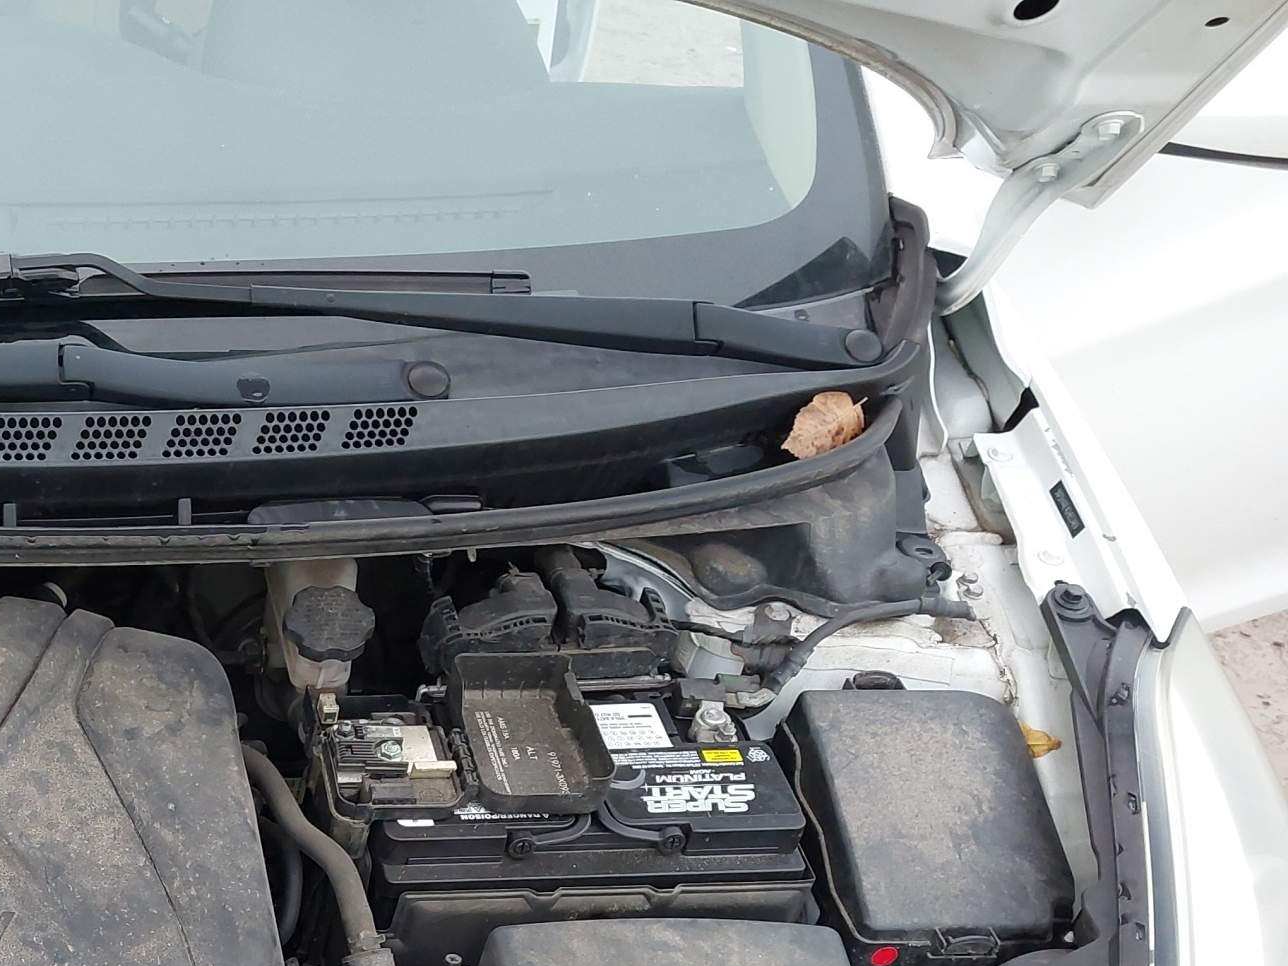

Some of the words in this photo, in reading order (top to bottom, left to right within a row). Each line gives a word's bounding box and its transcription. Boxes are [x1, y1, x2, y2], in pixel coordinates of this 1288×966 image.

[525, 745, 538, 760] ALT
[655, 772, 746, 783] PLATINUM
[641, 784, 756, 801] START
[647, 799, 749, 814] SUPER
